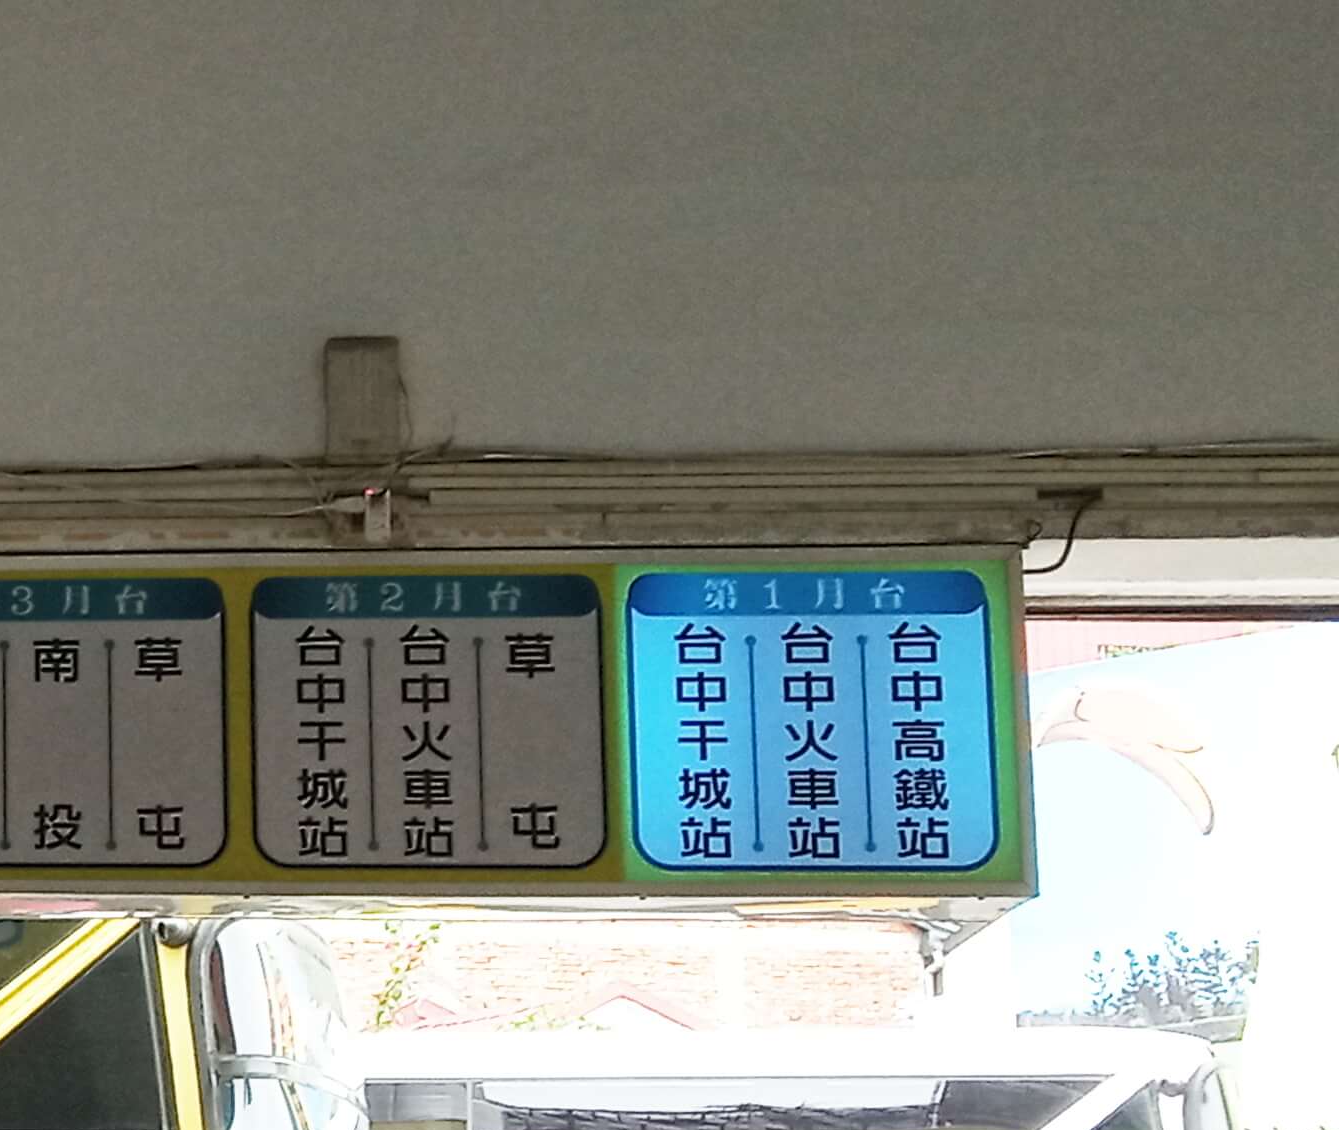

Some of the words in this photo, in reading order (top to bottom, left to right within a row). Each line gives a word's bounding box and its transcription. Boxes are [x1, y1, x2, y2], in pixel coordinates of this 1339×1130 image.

[295, 625, 348, 859] 台中干城站
[399, 624, 453, 858] 台中火車站
[672, 622, 733, 860] 台中干城站
[780, 622, 843, 860] 台中火車站
[887, 622, 952, 860] 台中高鐵站
